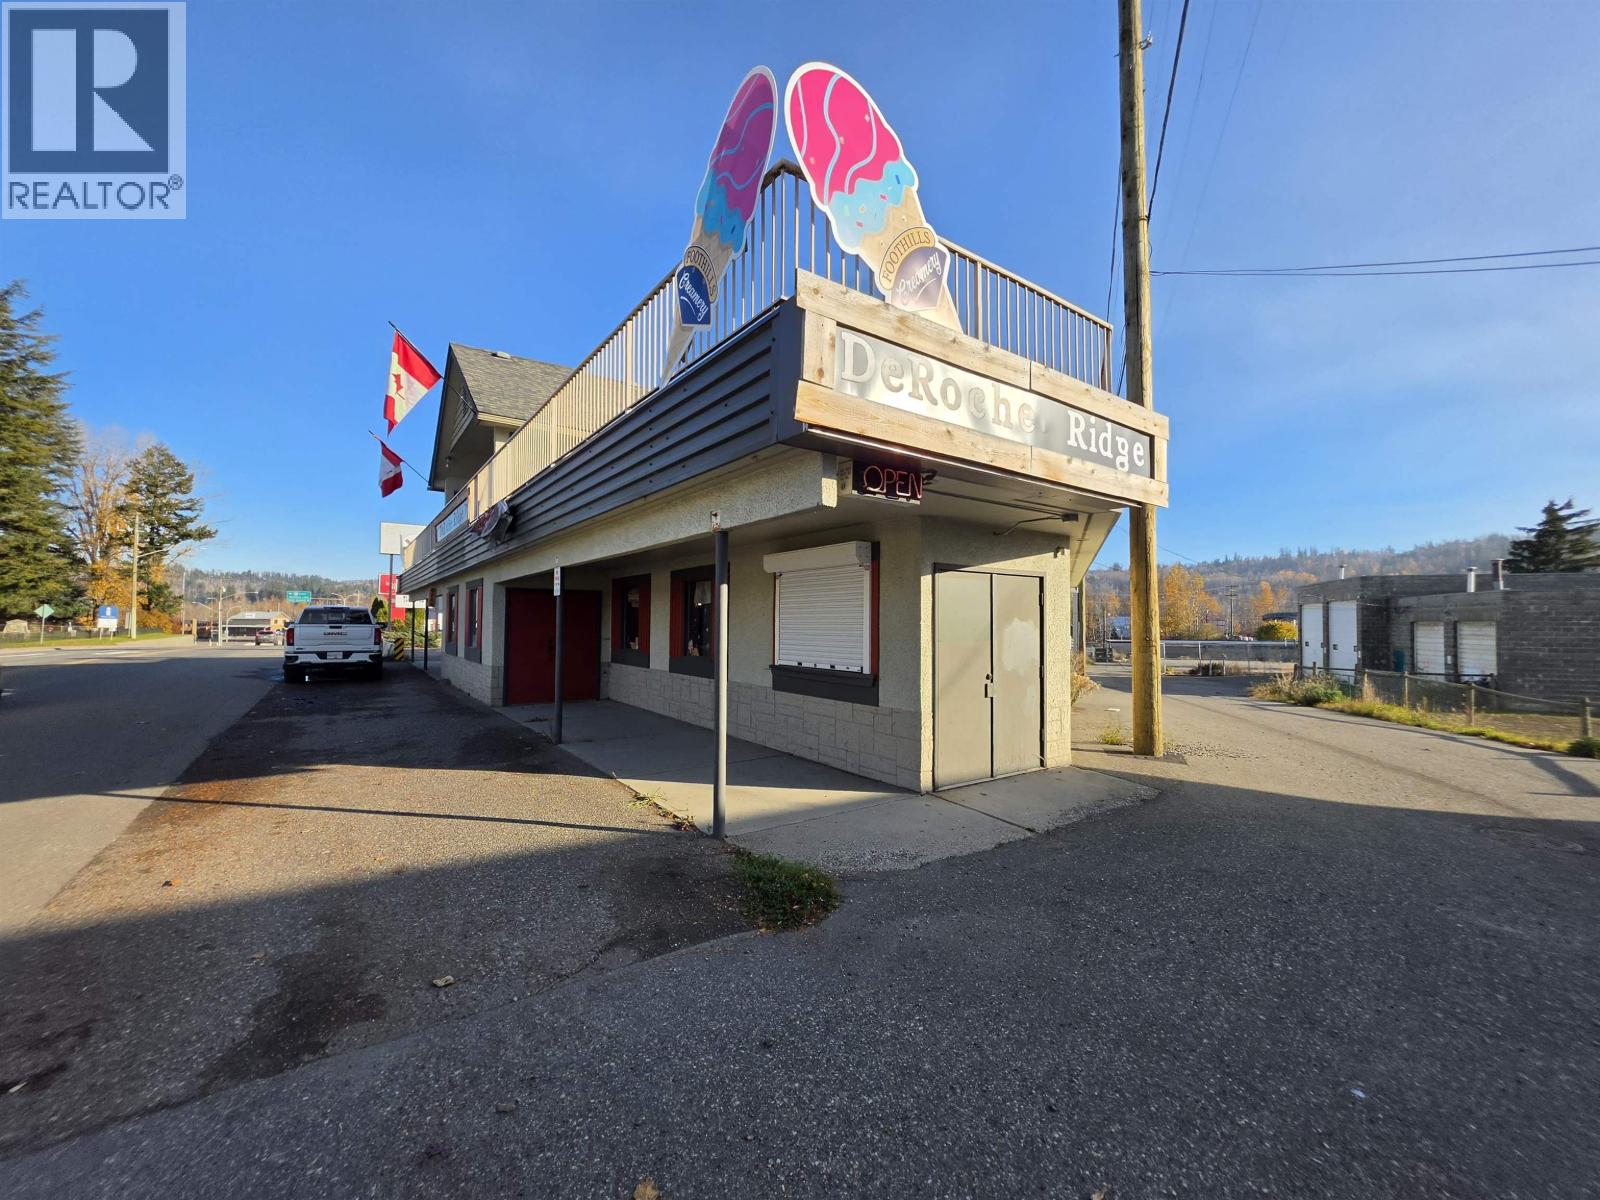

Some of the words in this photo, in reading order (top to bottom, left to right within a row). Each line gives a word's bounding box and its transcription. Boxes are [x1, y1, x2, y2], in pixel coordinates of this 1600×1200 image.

[686, 249, 717, 298] FOOTHILLS
[882, 230, 931, 283] FOOTHILLS
[898, 251, 943, 305] Creamery
[680, 270, 709, 322] Creamery
[840, 331, 1036, 433] DeRoche
[1067, 410, 1146, 472] Ridge
[863, 465, 923, 499] OPEN
